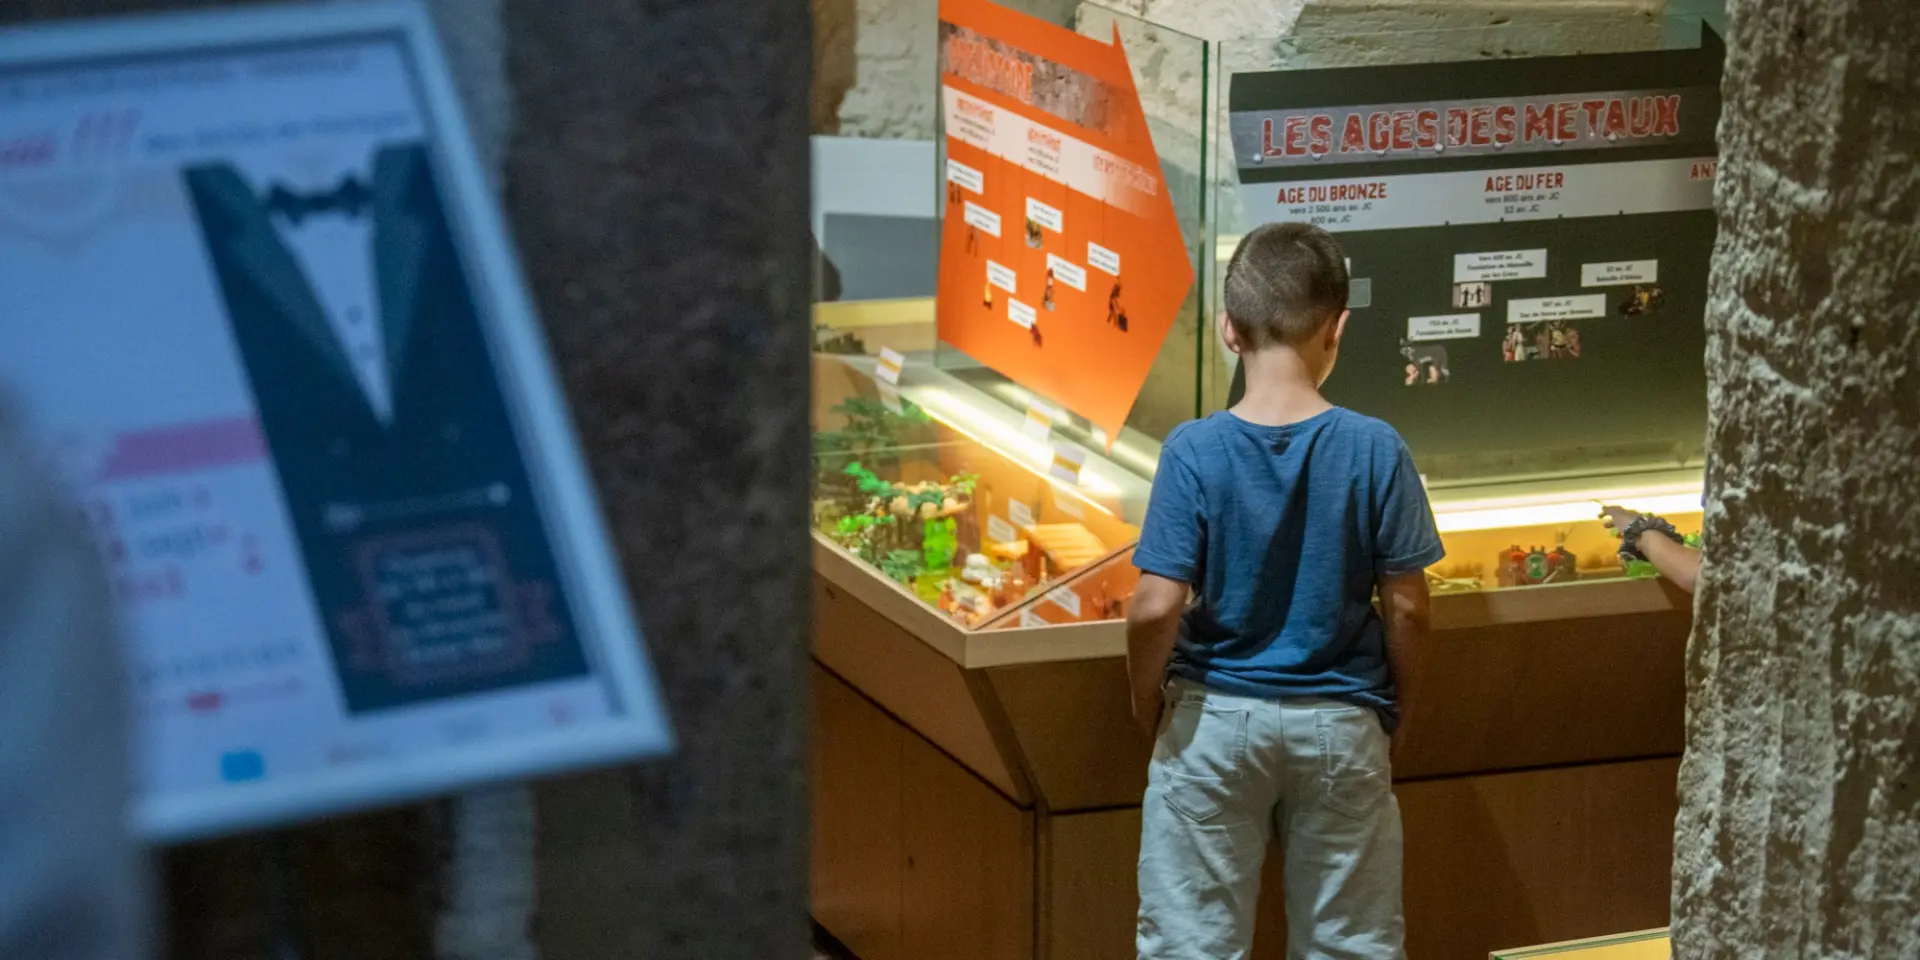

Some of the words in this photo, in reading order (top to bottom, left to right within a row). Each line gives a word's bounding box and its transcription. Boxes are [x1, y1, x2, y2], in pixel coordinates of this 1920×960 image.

[1263, 113, 1333, 158] LES
[1339, 108, 1441, 154] AGES
[1447, 104, 1517, 149] DES
[1523, 94, 1681, 144] METAUX
[1484, 176, 1513, 192] AGE
[1516, 174, 1534, 190] DU
[1536, 172, 1563, 189] FER
[1277, 187, 1305, 204] AGE
[1308, 185, 1327, 202] DU
[1330, 182, 1387, 201] BRONZE
[1289, 206, 1306, 215] vers
[1333, 204, 1346, 212] ans
[1361, 202, 1373, 211] JC
[1341, 214, 1352, 223] JC
